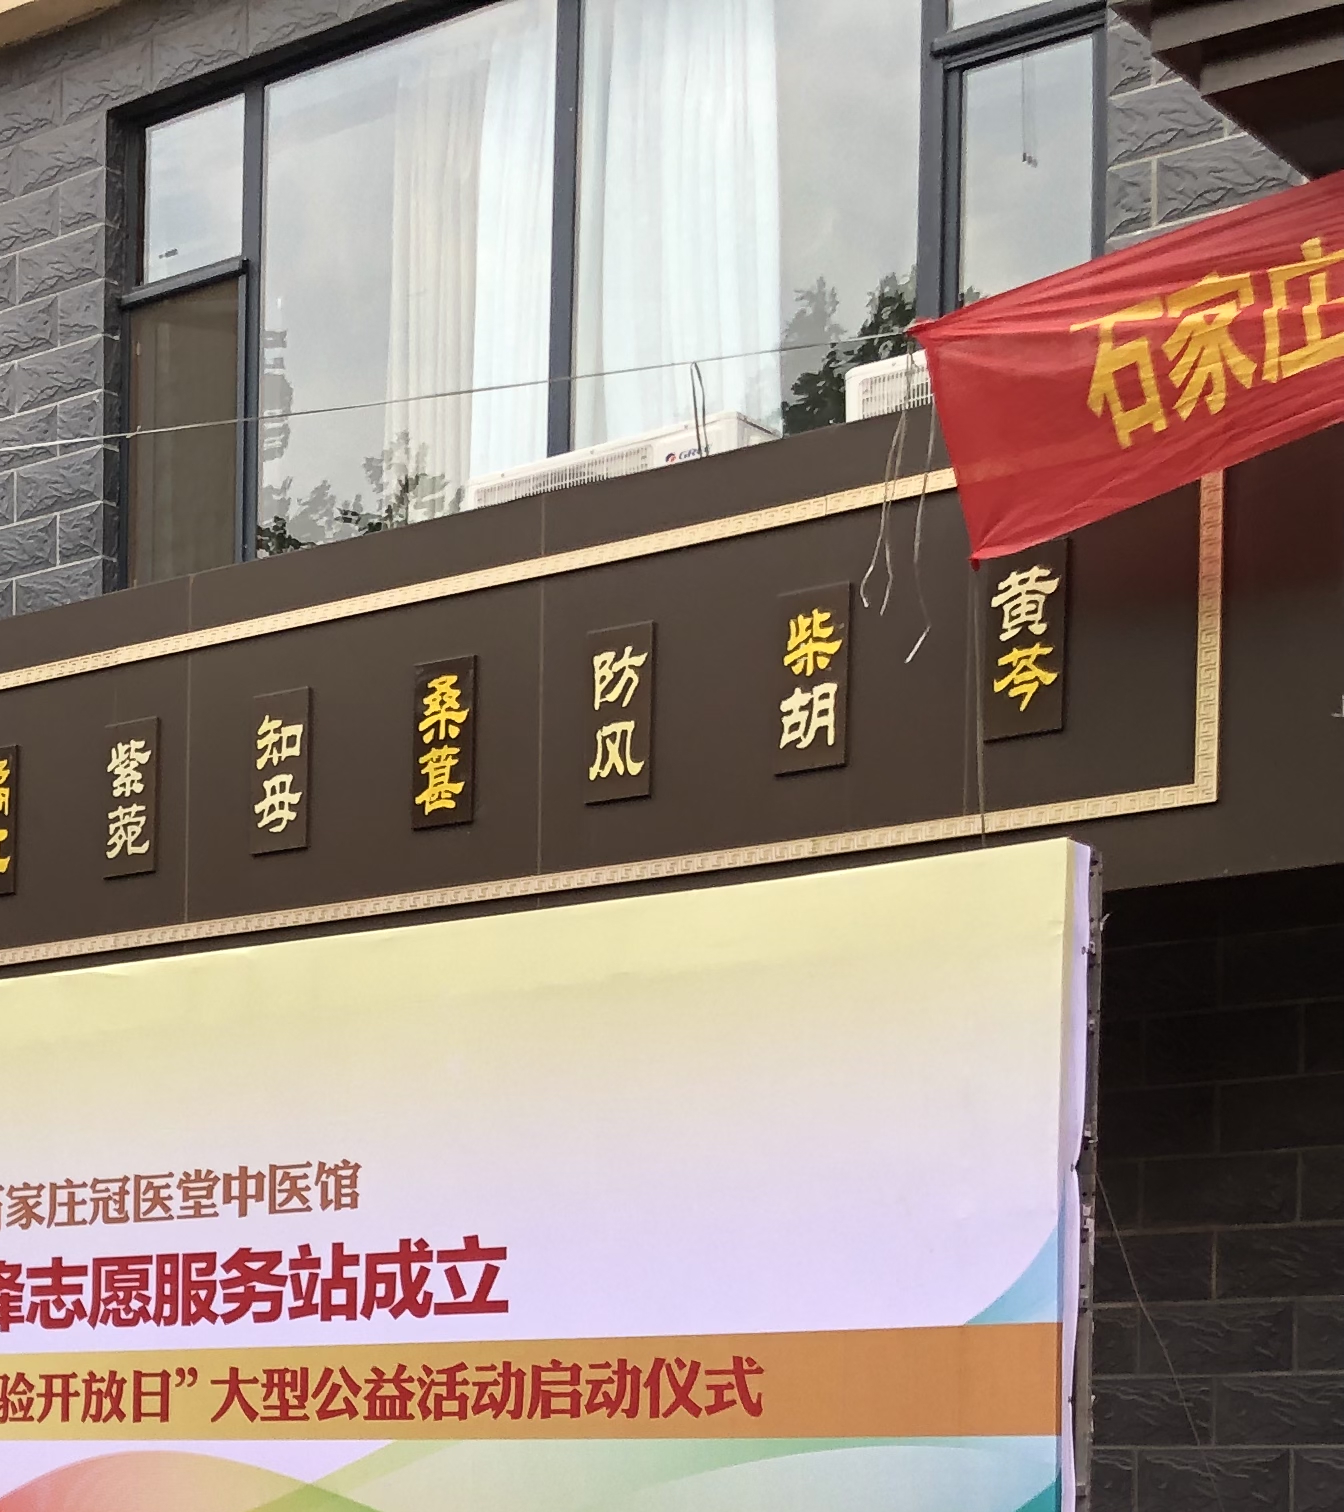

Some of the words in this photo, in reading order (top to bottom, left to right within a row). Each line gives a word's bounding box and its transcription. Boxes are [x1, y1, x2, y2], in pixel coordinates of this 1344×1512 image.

[780, 608, 842, 750] 柴胡
[991, 566, 1059, 712] 黄芩
[254, 714, 303, 834] 知母
[414, 674, 470, 816] 桑葚
[588, 645, 648, 781] 防风
[105, 739, 152, 859] 紫菀
